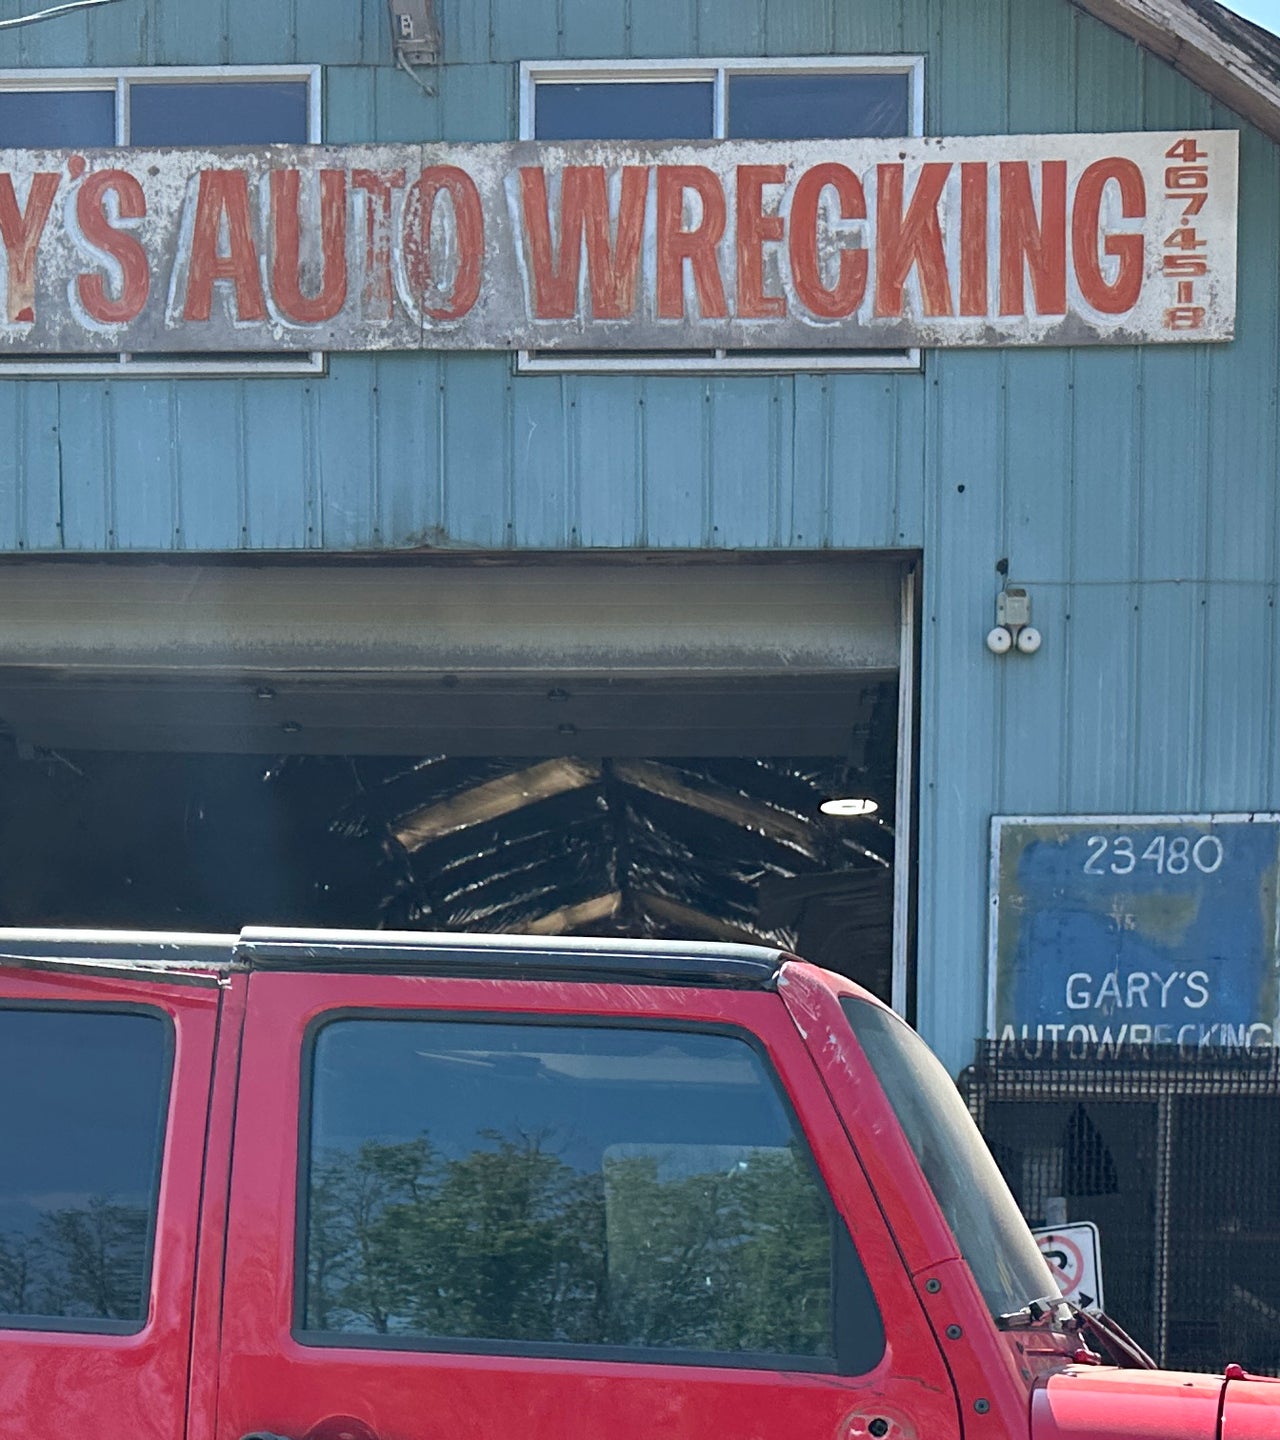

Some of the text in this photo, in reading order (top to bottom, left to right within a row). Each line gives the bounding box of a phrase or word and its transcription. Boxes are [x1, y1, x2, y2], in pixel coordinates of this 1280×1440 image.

[183, 164, 485, 322] AUTO
[519, 156, 1147, 320] WRECKING
[1083, 835, 1224, 875] 23480
[1065, 970, 1210, 1010] GARY'S
